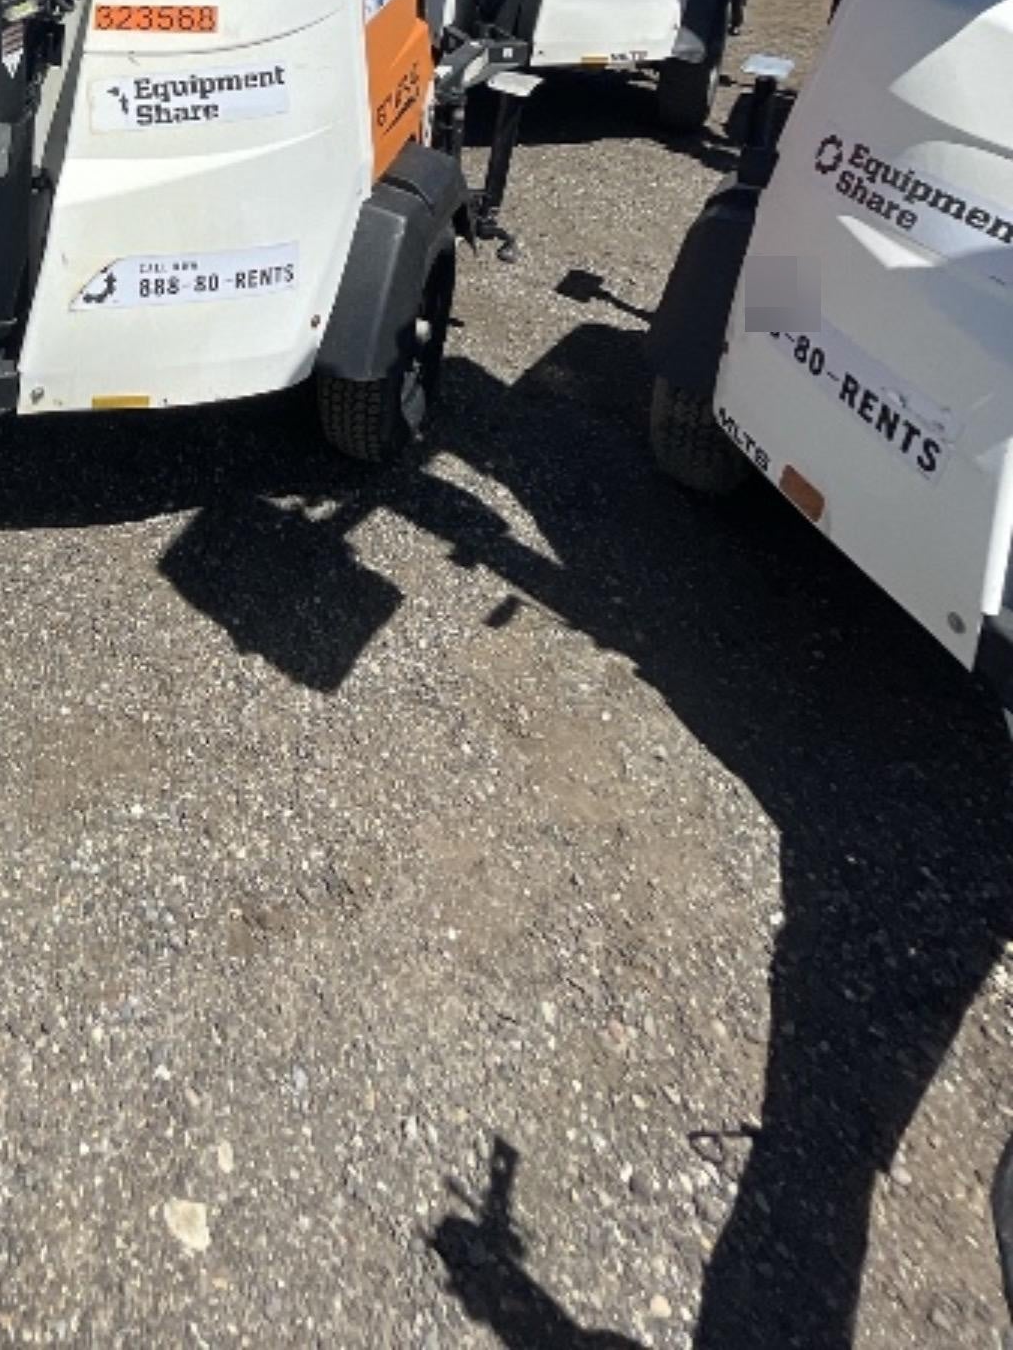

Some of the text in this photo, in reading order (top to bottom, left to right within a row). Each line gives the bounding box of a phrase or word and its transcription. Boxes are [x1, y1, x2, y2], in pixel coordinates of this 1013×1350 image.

[96, 5, 217, 32] 323568
[134, 65, 286, 103] Equipment
[136, 103, 220, 126] Share
[835, 169, 919, 231] Share
[769, 331, 942, 473] -80-RENTS
